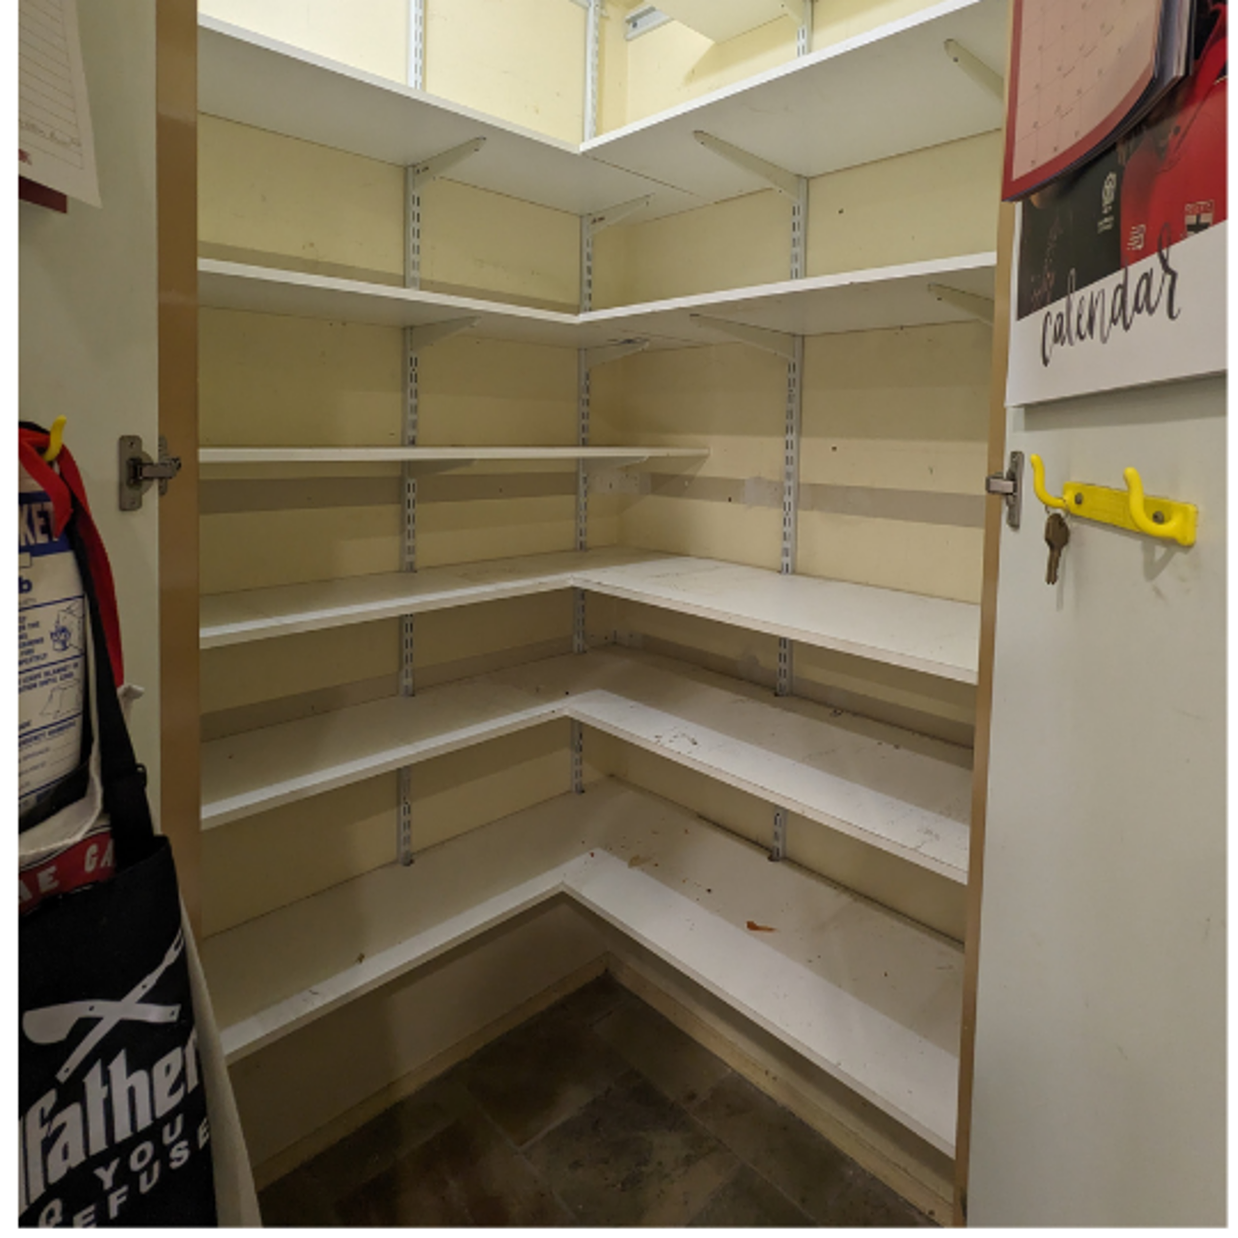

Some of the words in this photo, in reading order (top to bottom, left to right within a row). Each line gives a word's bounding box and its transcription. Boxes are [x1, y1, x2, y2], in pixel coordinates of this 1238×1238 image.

[1041, 222, 1181, 367] calendar
[18, 1030, 200, 1217] father
[94, 1114, 184, 1191] YOU
